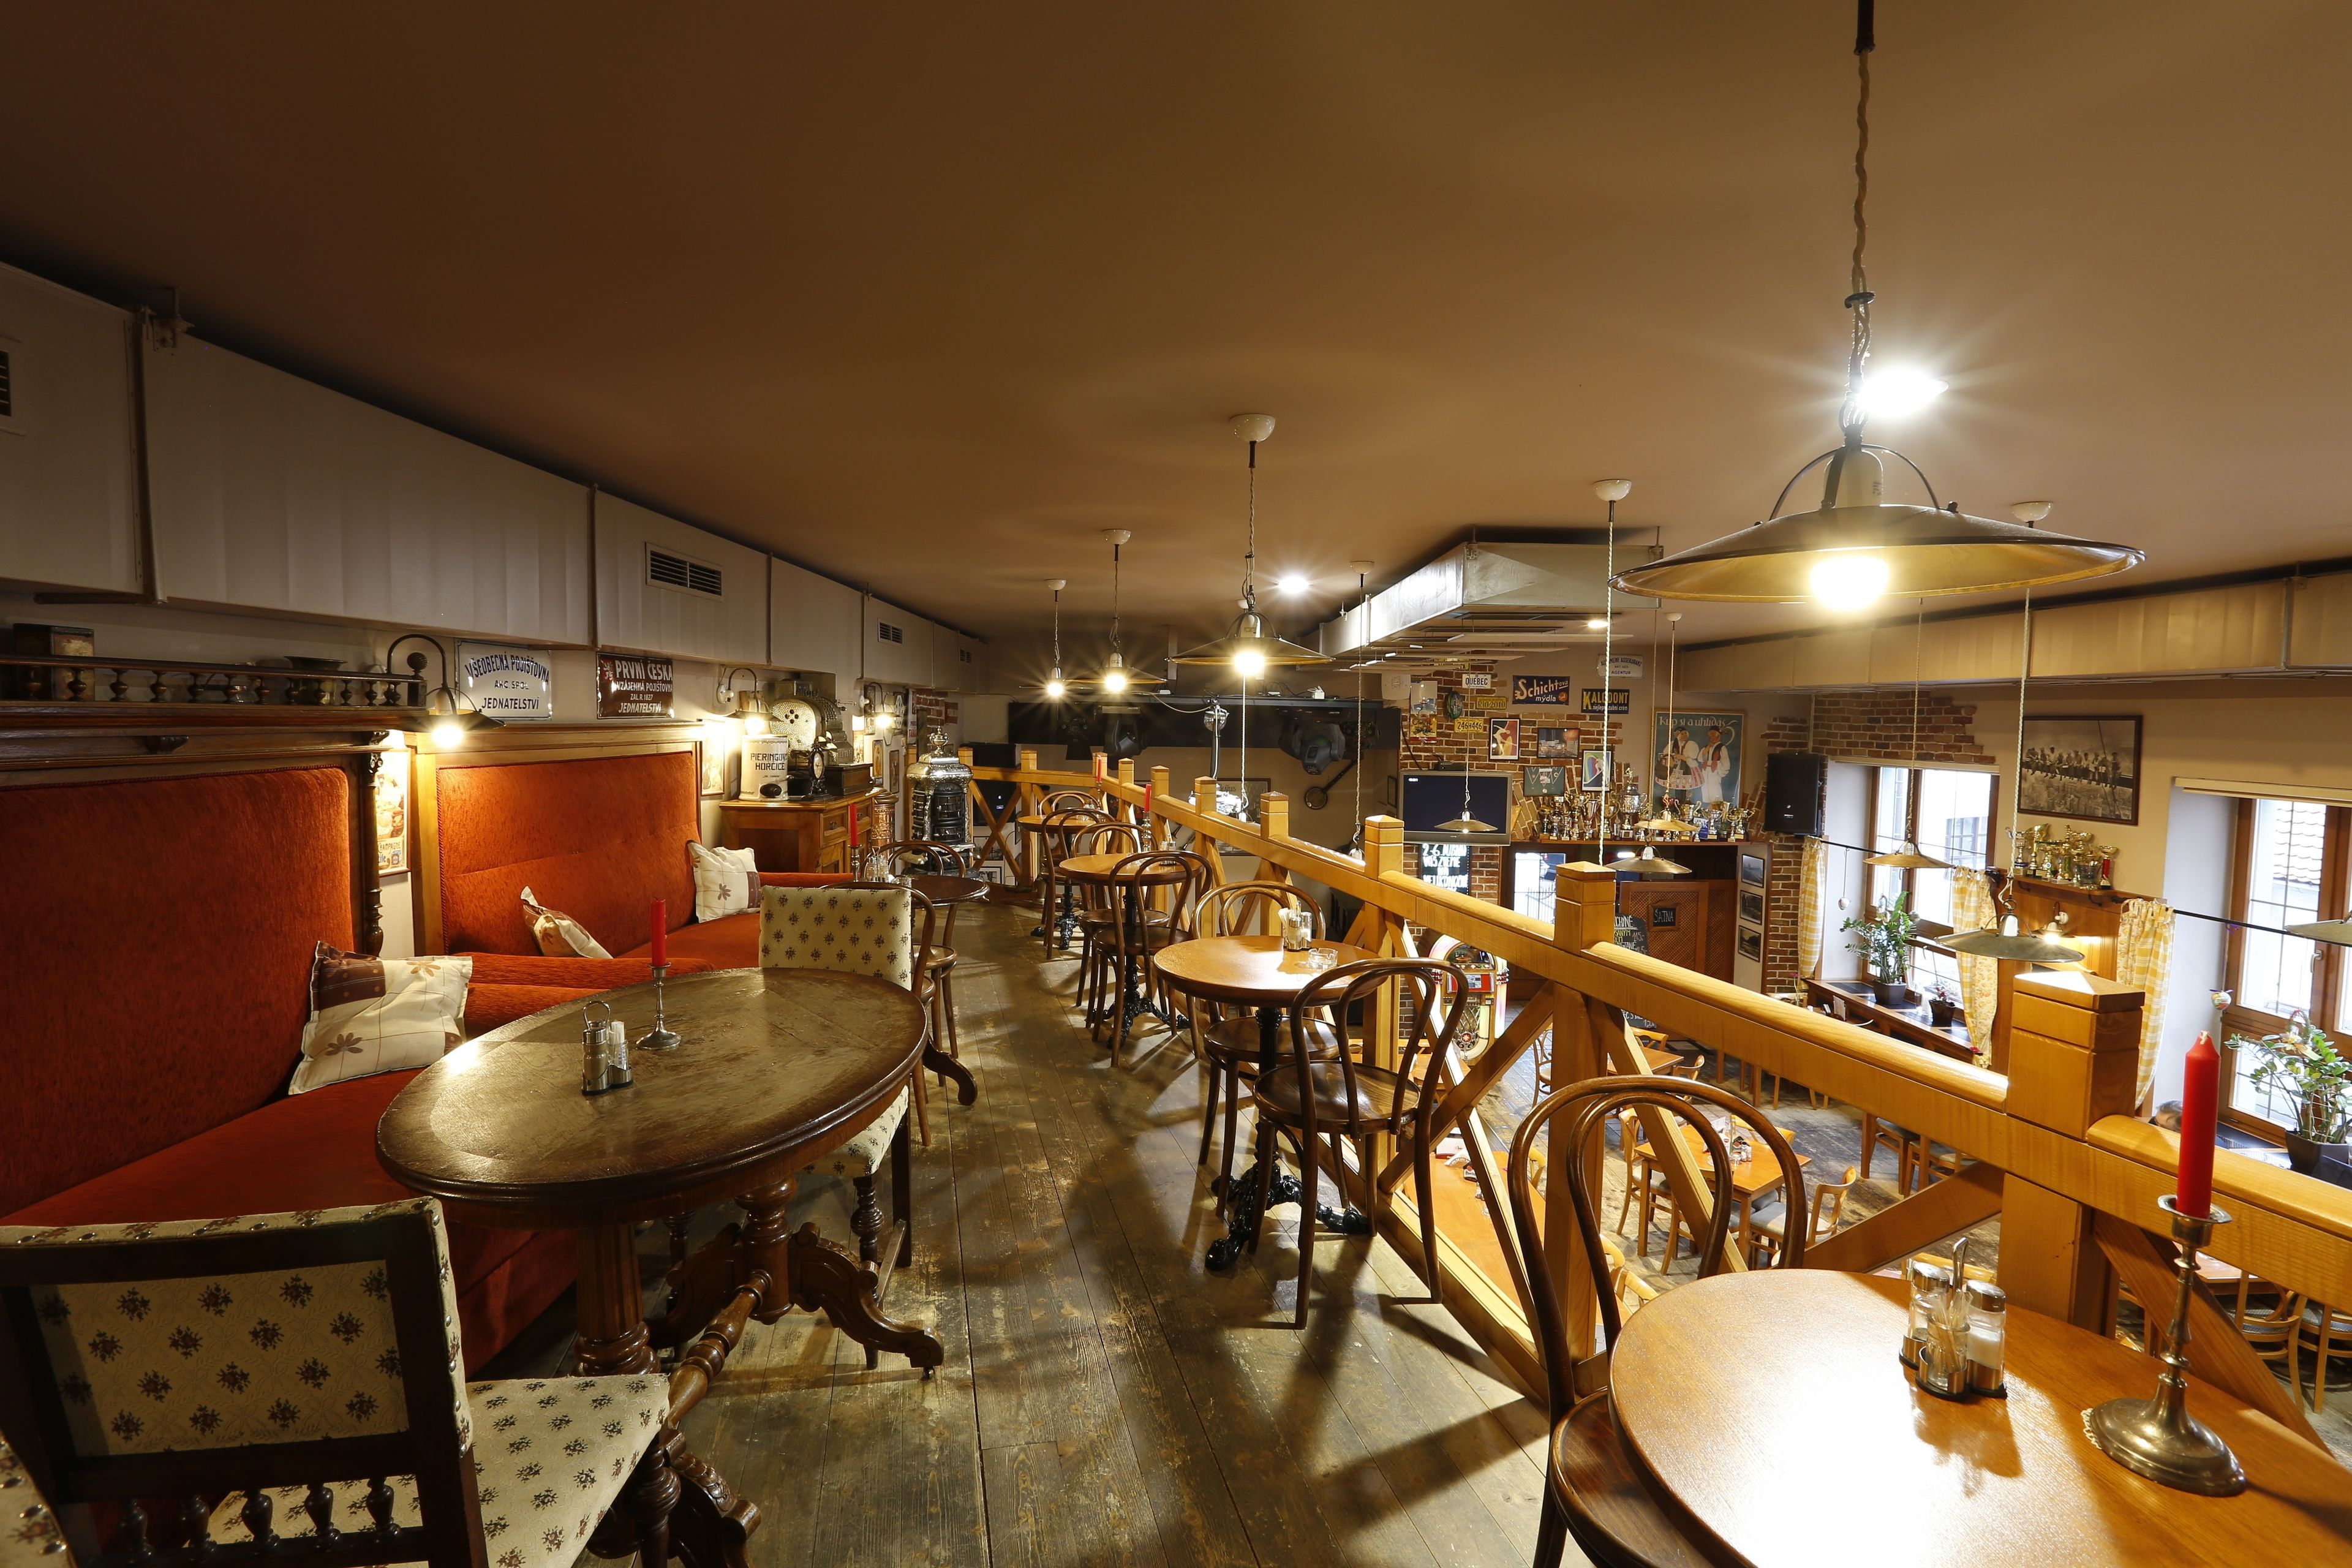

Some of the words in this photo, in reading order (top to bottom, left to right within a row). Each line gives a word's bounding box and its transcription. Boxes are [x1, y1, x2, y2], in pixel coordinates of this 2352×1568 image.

[465, 651, 509, 680] VŠEOBECNÁ
[510, 654, 549, 685] POJIŠŤOVNA
[614, 660, 645, 679] PRVNÍ
[481, 696, 540, 710] JEDNATELSTVÍ
[618, 701, 662, 713] JEDNATELSTVÍ
